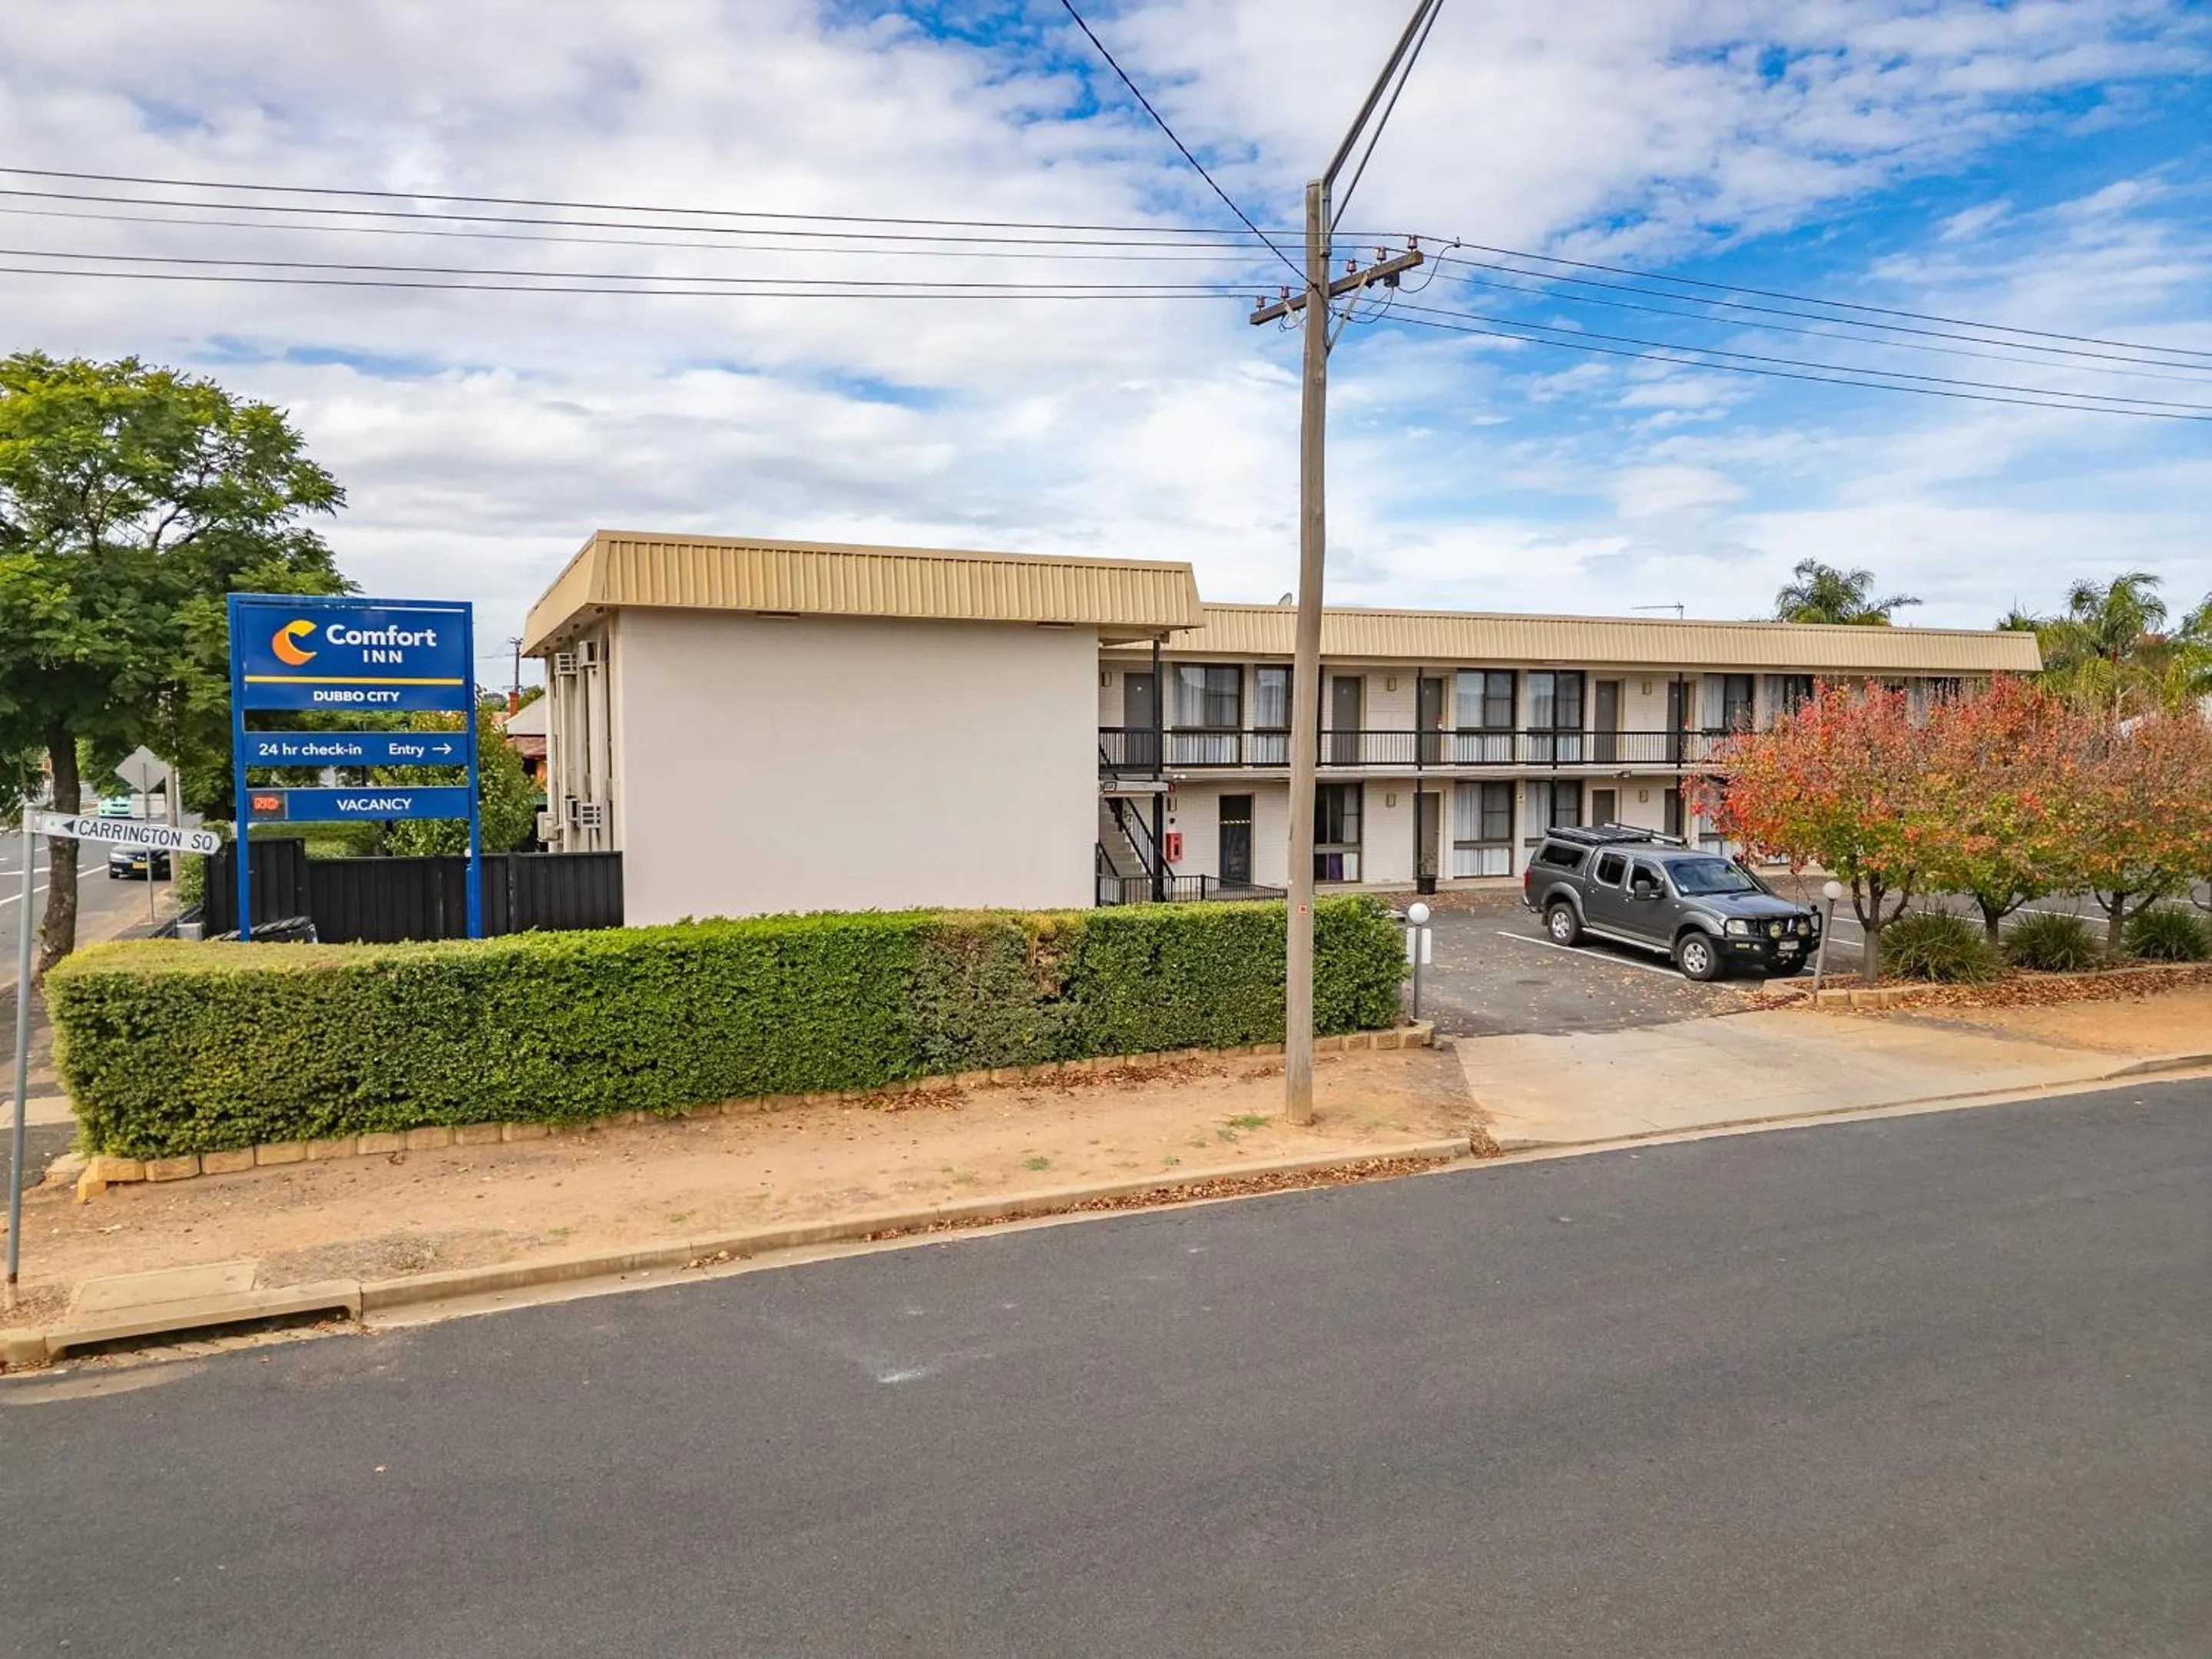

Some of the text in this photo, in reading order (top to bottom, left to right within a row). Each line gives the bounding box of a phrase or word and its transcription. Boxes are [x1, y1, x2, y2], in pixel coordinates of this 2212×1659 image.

[326, 623, 438, 647] Comfort
[363, 649, 403, 664] INN
[313, 690, 400, 703] DUBBO CITY
[259, 742, 425, 758] 24 hr check-in Entry
[336, 797, 412, 811] VACANCY
[78, 820, 214, 851] CARRINGTON SQ
